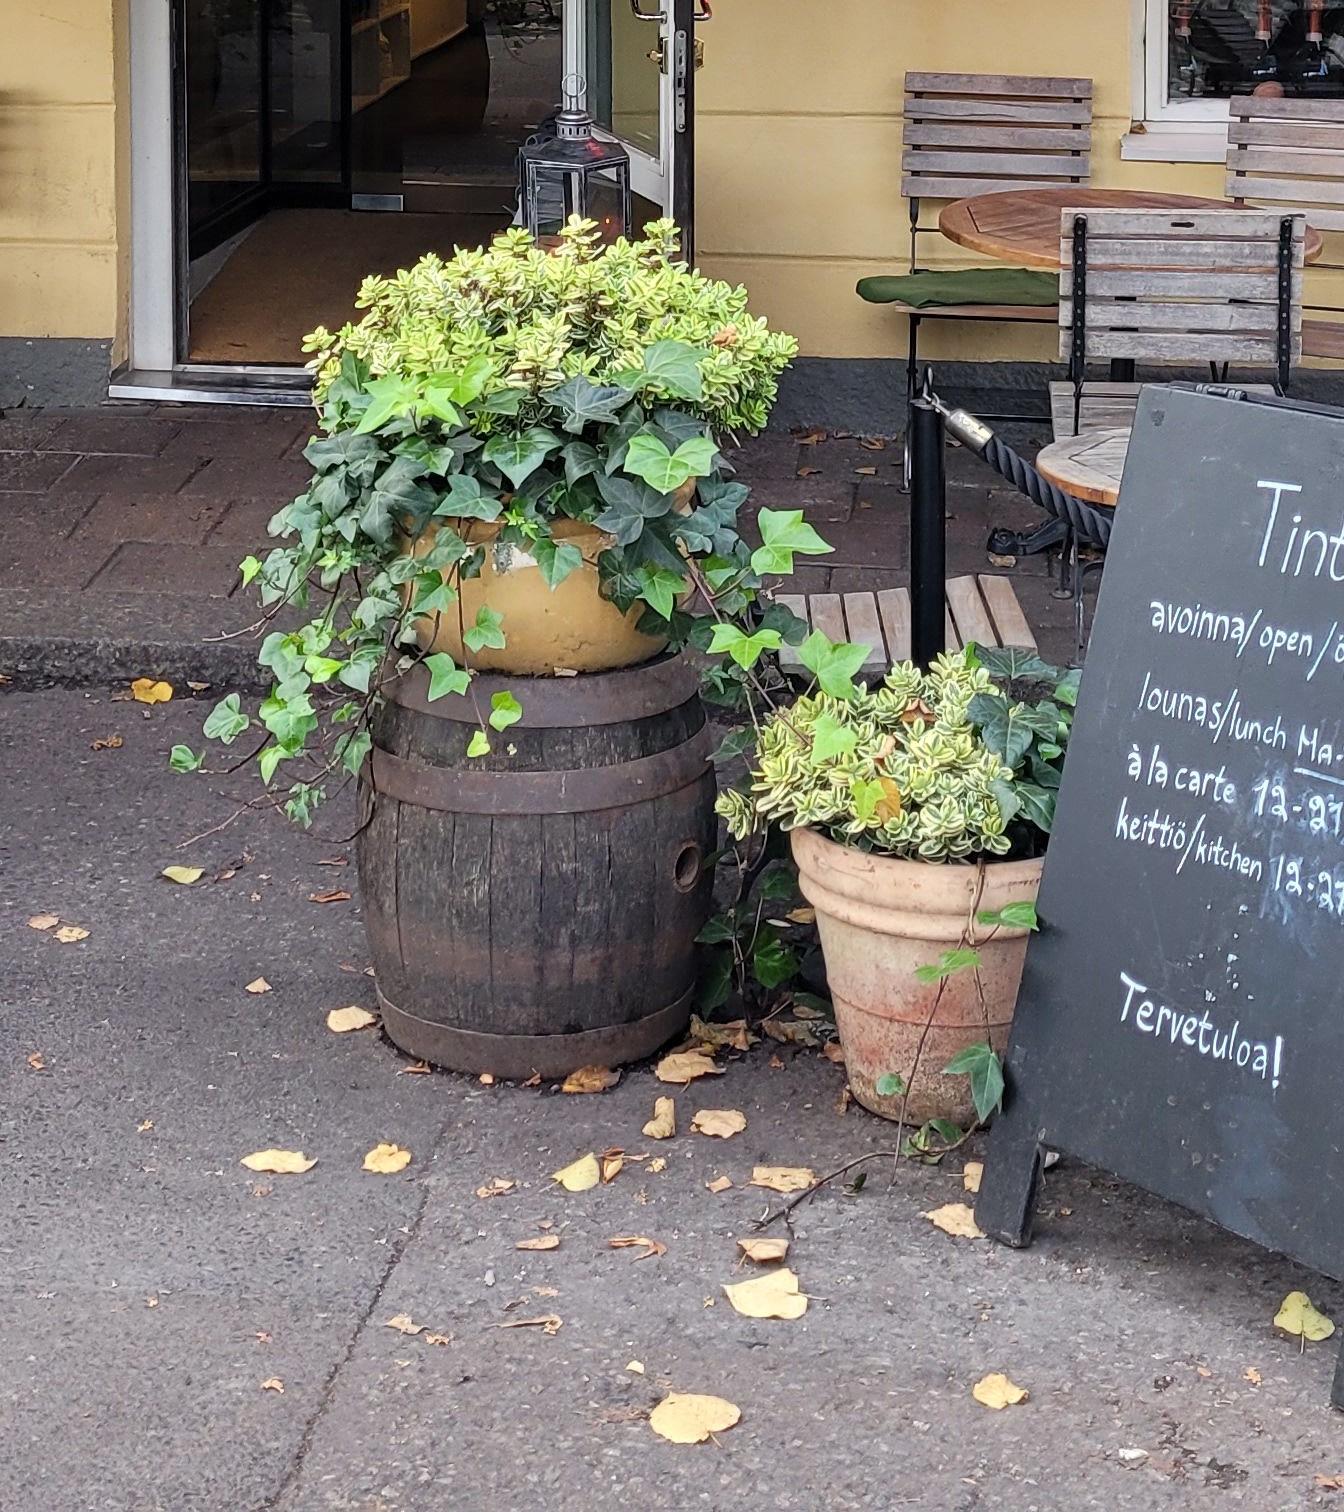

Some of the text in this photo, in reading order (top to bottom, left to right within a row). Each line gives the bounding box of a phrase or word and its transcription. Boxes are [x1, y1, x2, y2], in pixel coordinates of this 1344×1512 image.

[1127, 743, 1140, 783] à
[1148, 744, 1169, 789] la
[1175, 766, 1237, 804] carte
[1120, 971, 1284, 1090] Tervetuloa!
